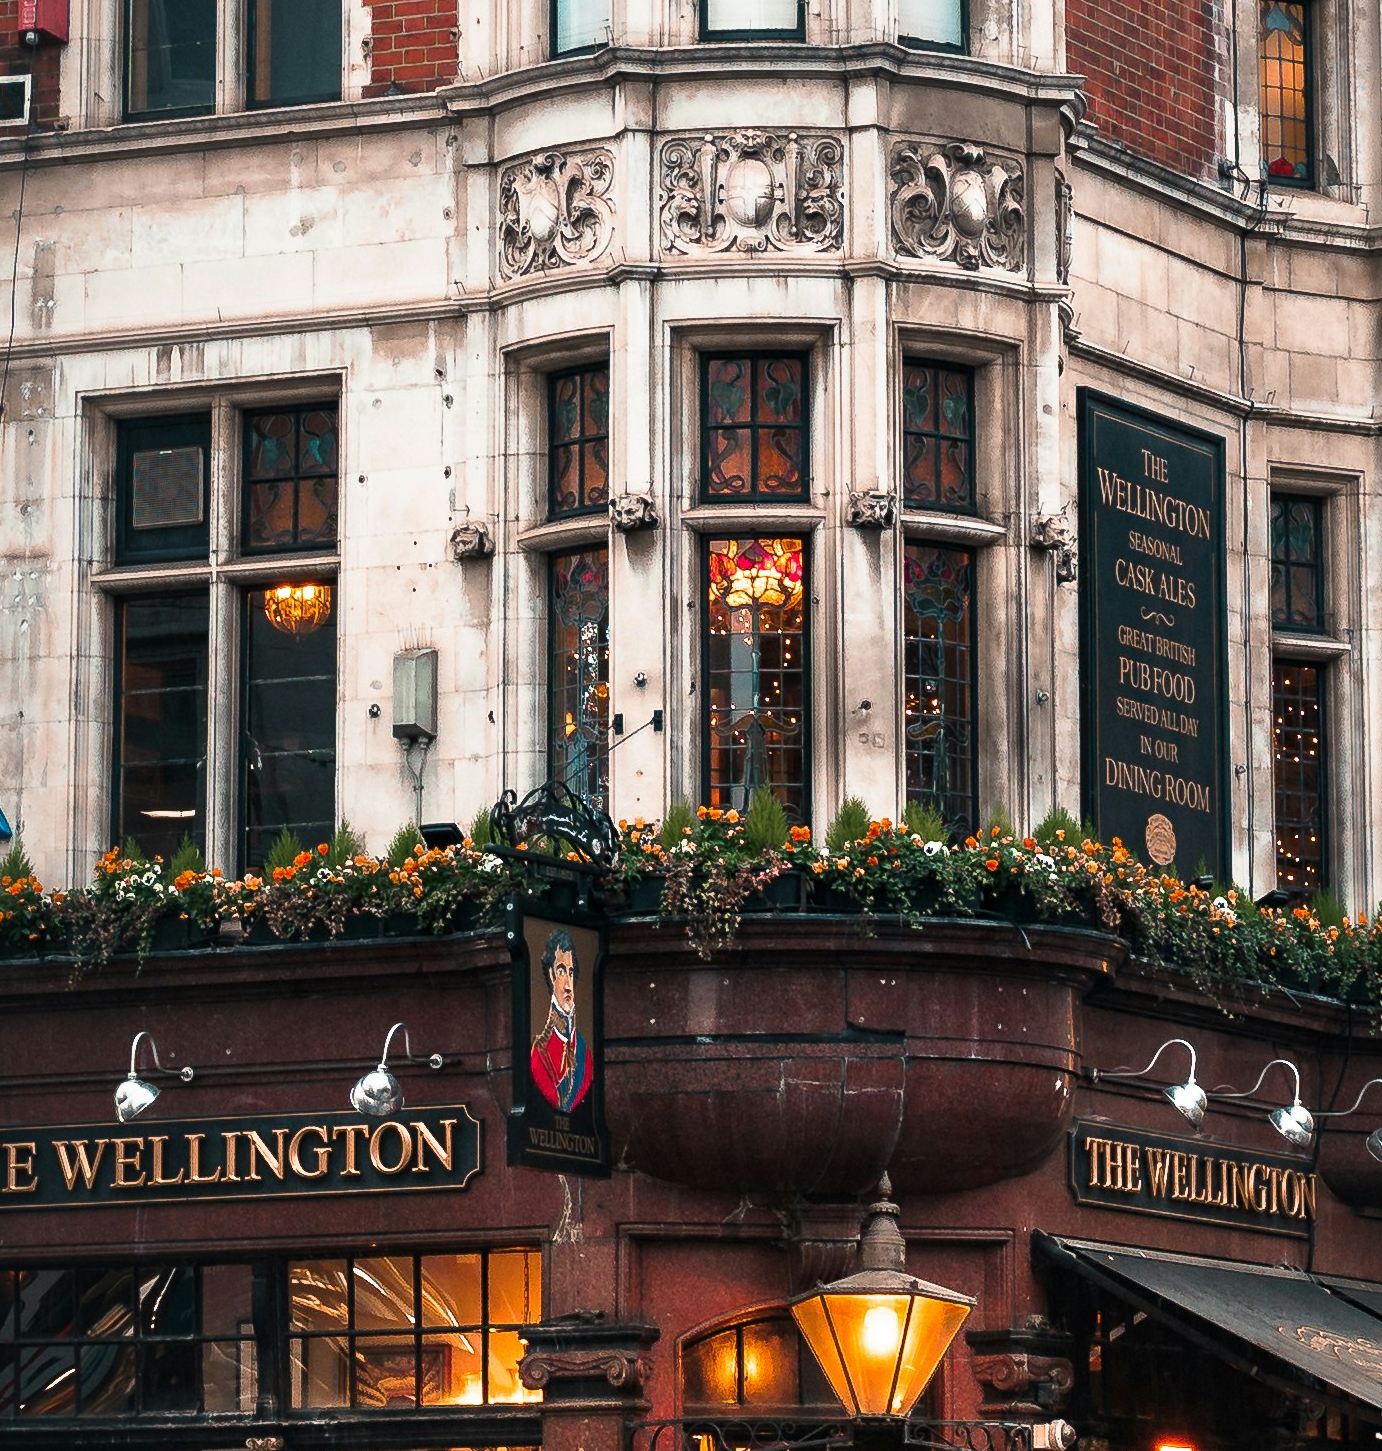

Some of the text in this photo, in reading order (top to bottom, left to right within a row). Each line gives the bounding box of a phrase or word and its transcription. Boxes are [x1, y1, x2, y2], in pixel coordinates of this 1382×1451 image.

[1141, 449, 1169, 484] THE
[1097, 466, 1210, 541] WELLINGTON
[1129, 530, 1183, 566] SEASONAL
[1115, 558, 1196, 609] CASK ALES
[1118, 624, 1196, 667] GREAT BRITISH
[1119, 656, 1195, 704] PUB FOOD
[1116, 696, 1199, 738] SERVED ALL DAY
[1139, 735, 1179, 763] IN OUR
[1105, 757, 1210, 814] DINING ROOM
[529, 1127, 595, 1155] WELLINGTON
[554, 1116, 571, 1130] THE
[52, 1119, 458, 1191] WELLINGTON
[1085, 1137, 1317, 1220] THE WELLINGTON
